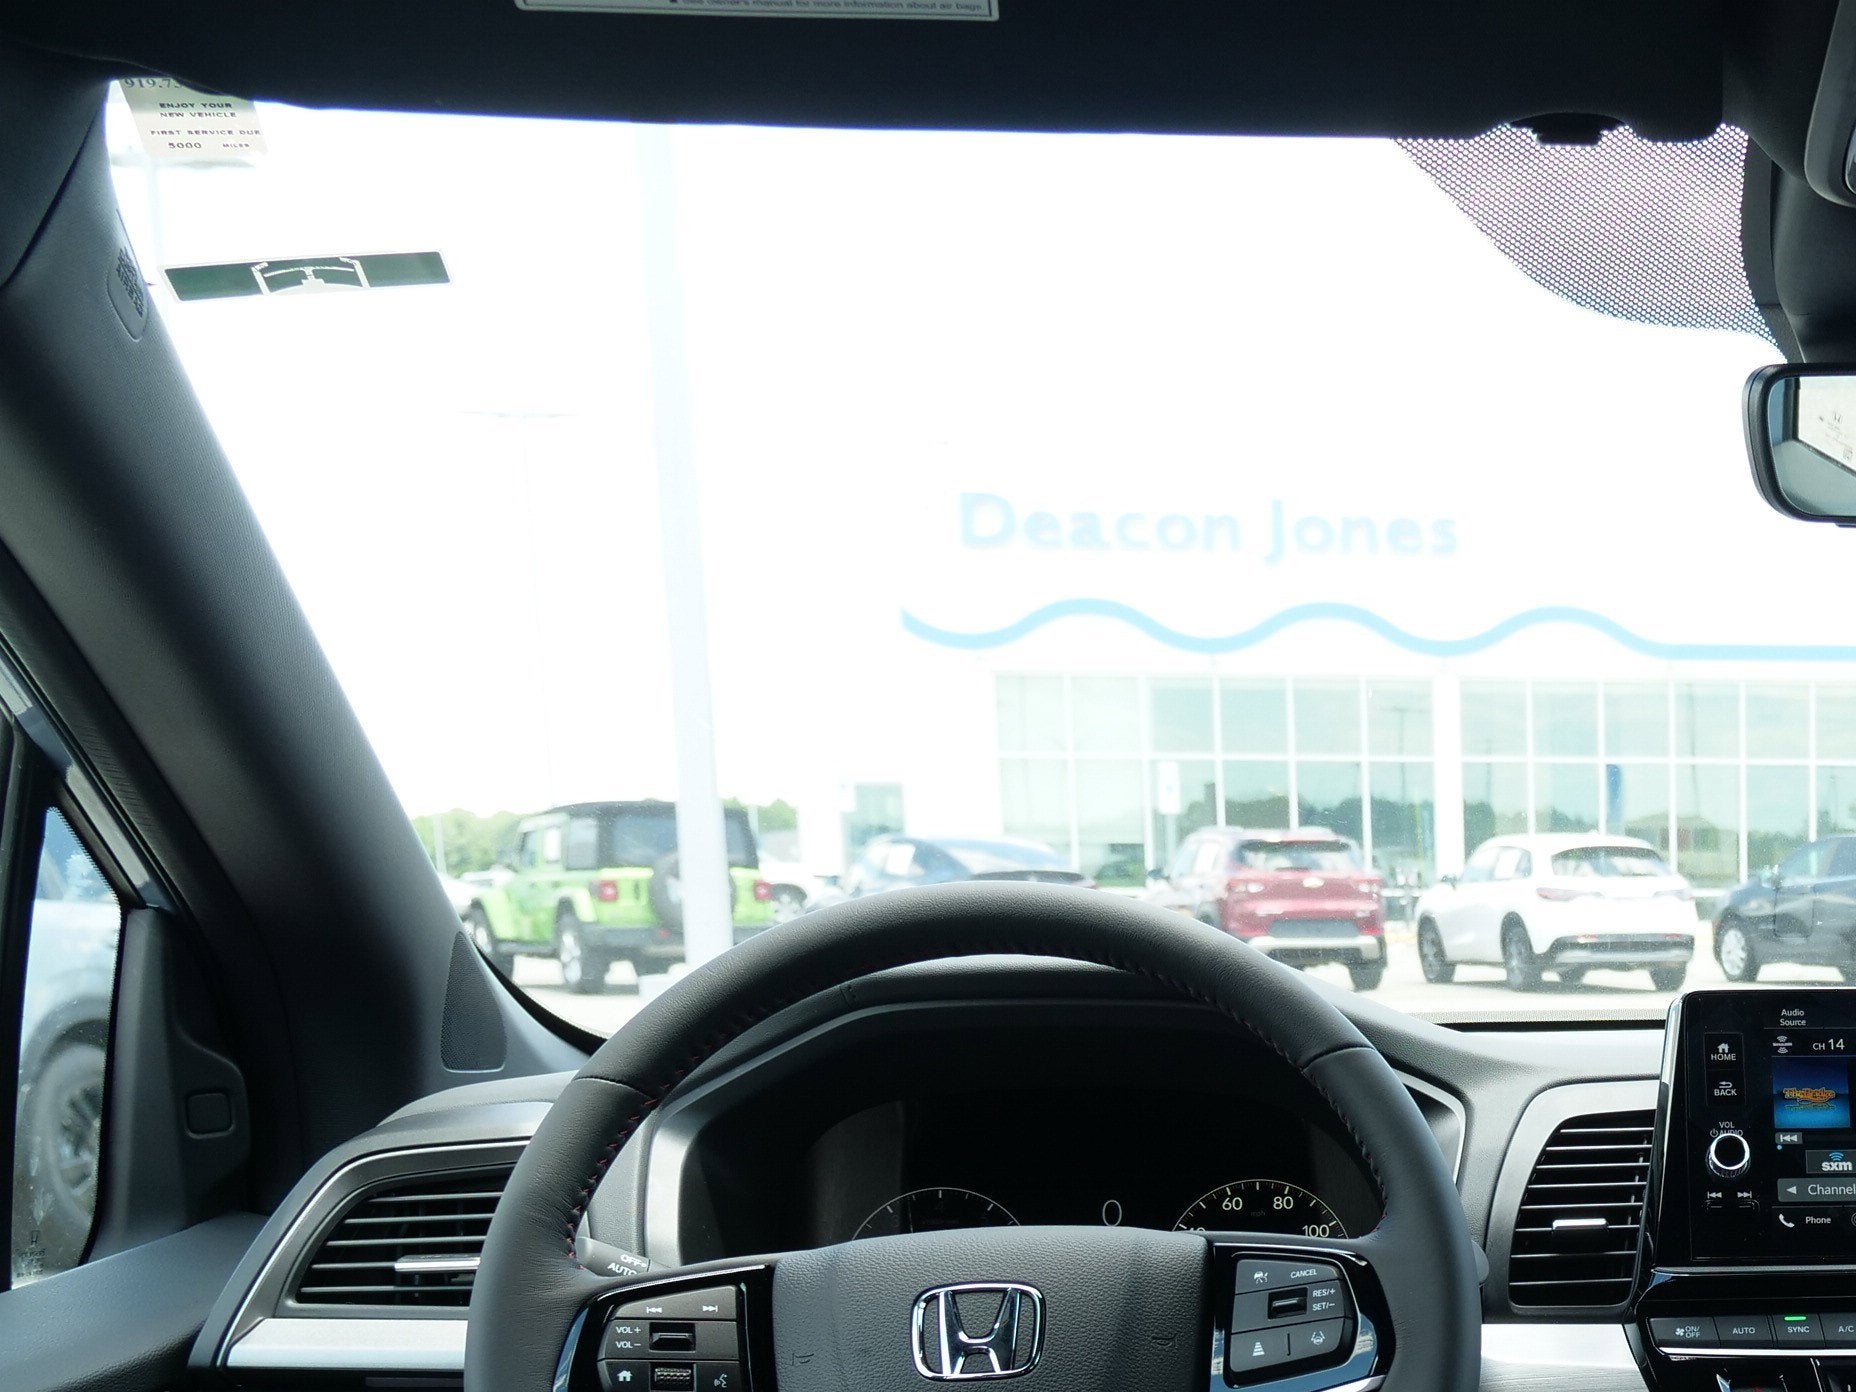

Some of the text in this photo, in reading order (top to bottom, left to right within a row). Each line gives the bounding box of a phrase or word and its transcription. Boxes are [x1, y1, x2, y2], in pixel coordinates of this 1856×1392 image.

[959, 491, 1458, 566] Deacon Jones
[1781, 1008, 1804, 1017] Audio
[1780, 1018, 1806, 1026] Source
[1812, 1038, 1845, 1050] CH 14
[1710, 1053, 1736, 1061] HOME
[1714, 1088, 1737, 1096] BACK
[1719, 1121, 1735, 1129] VOL
[1821, 1161, 1853, 1171] sxm
[1808, 1184, 1856, 1196] Channel
[1222, 1197, 1243, 1210] 60
[1273, 1196, 1294, 1210] 80
[1102, 1200, 1122, 1227] 0
[1805, 1216, 1831, 1225] Phone
[1302, 1224, 1330, 1238] 100
[621, 1255, 641, 1266] OFF
[1290, 1269, 1317, 1279] CANCEL
[1312, 1288, 1336, 1298] RES/+
[1685, 1325, 1700, 1333] ON/
[1732, 1327, 1756, 1335] AUTO
[1787, 1326, 1810, 1334] SYNC
[1838, 1325, 1854, 1333] A/C
